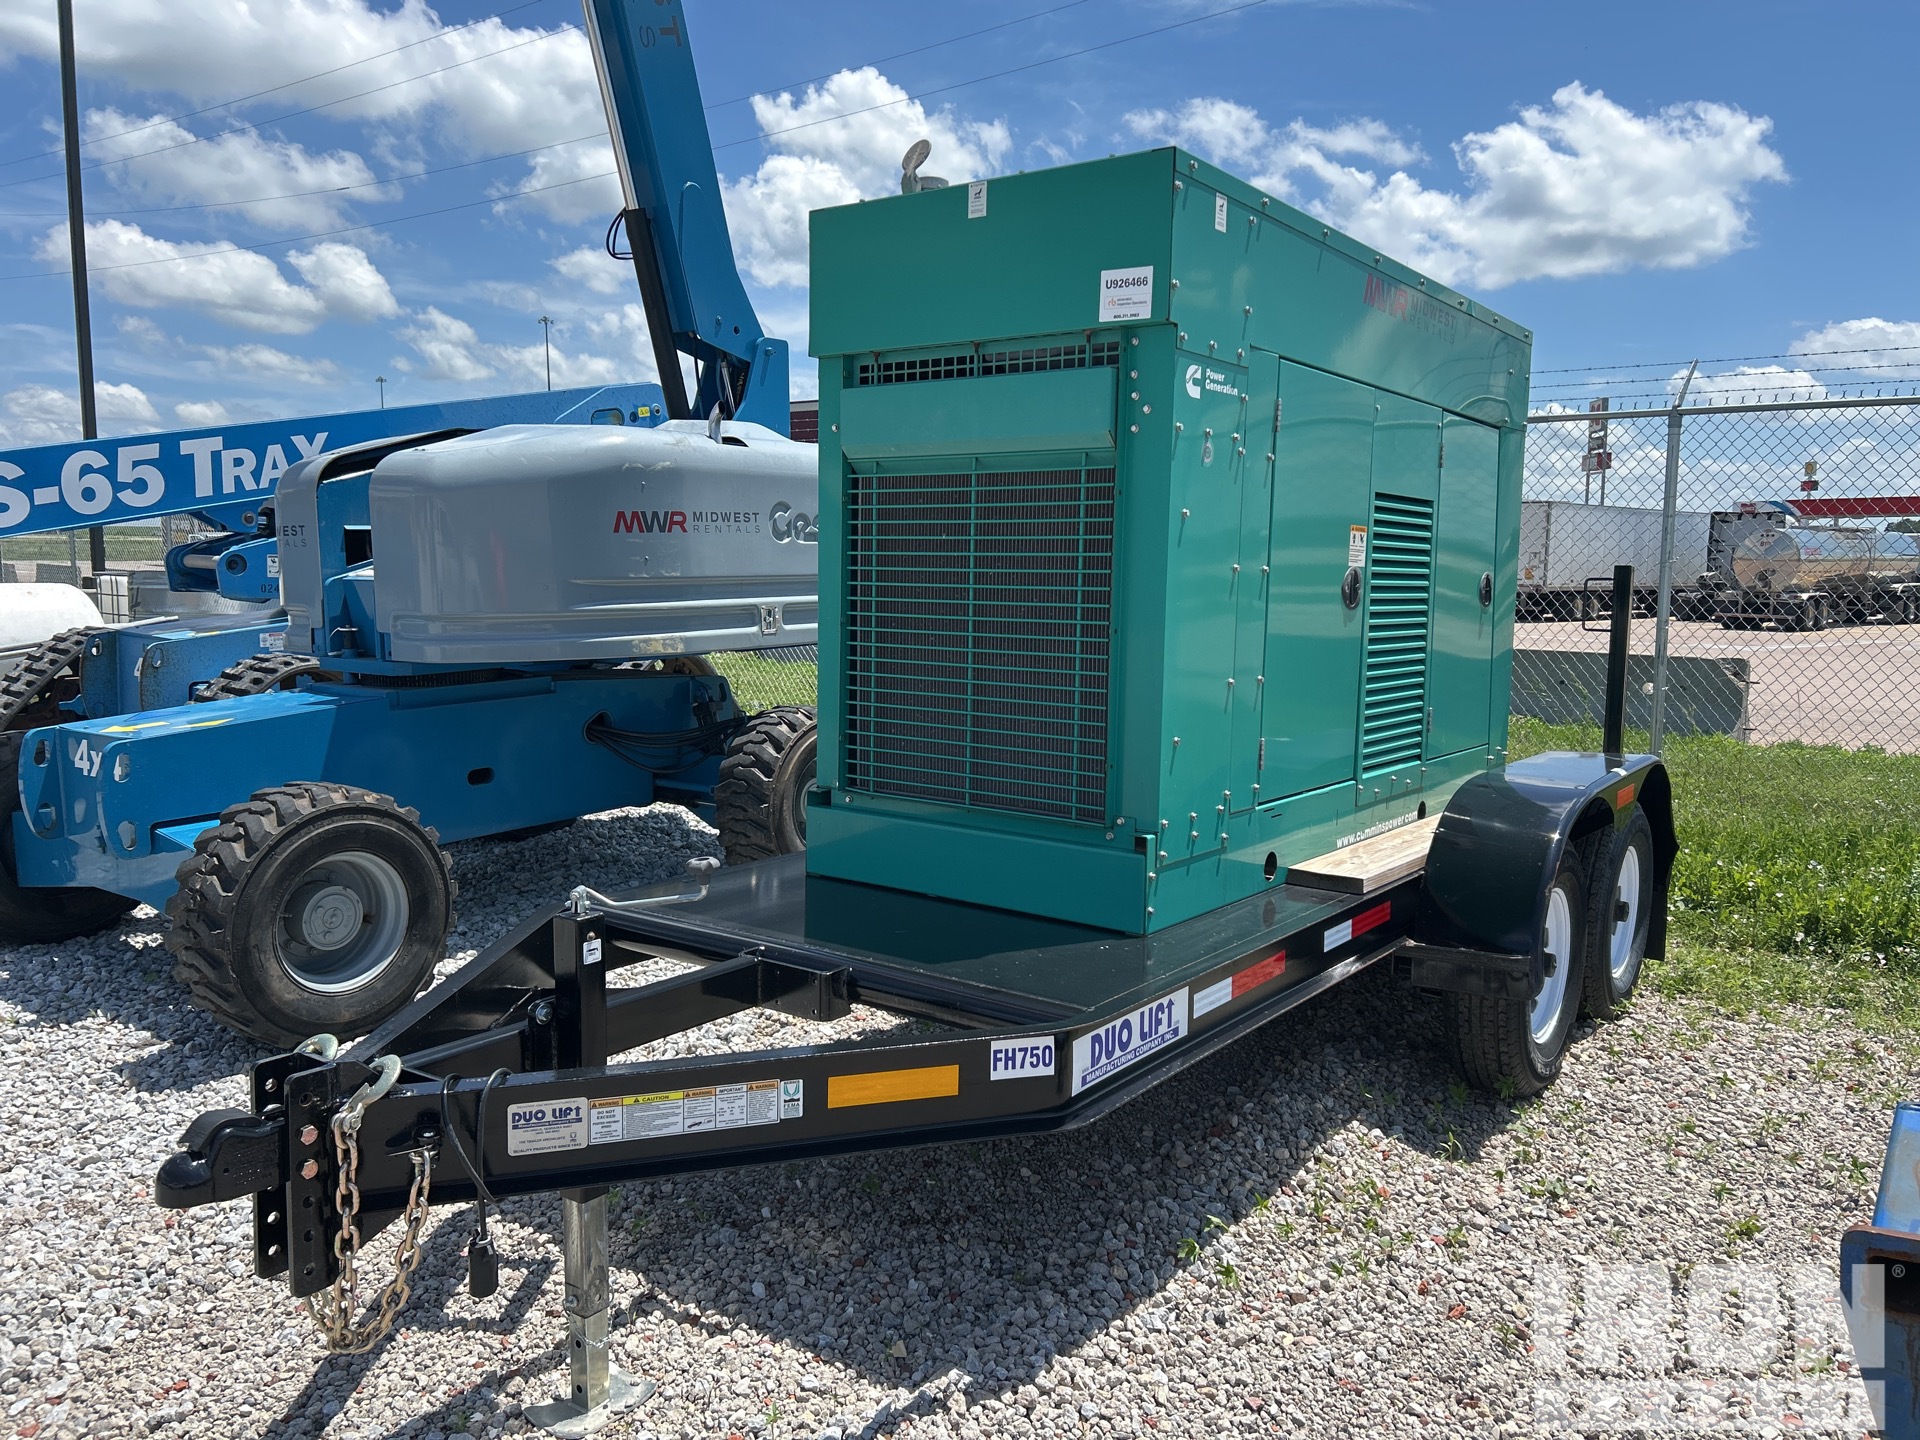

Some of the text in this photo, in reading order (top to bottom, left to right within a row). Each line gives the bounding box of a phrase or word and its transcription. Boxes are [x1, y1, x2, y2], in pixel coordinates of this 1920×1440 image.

[1105, 276, 1149, 290] U926466
[1363, 272, 1408, 322] MWR
[1410, 294, 1457, 331] MIDWEST
[1205, 368, 1225, 382] Power
[1205, 379, 1239, 397] Generation
[613, 510, 688, 534] MWR
[692, 511, 760, 523] MIDWEST
[693, 524, 761, 534] RENTALS
[1090, 997, 1175, 1069] DUO LIFT
[992, 1044, 1053, 1072] FH750
[1086, 1030, 1175, 1083] MANUFACTURING COMPANY, INC.
[511, 1109, 546, 1124] DUO
